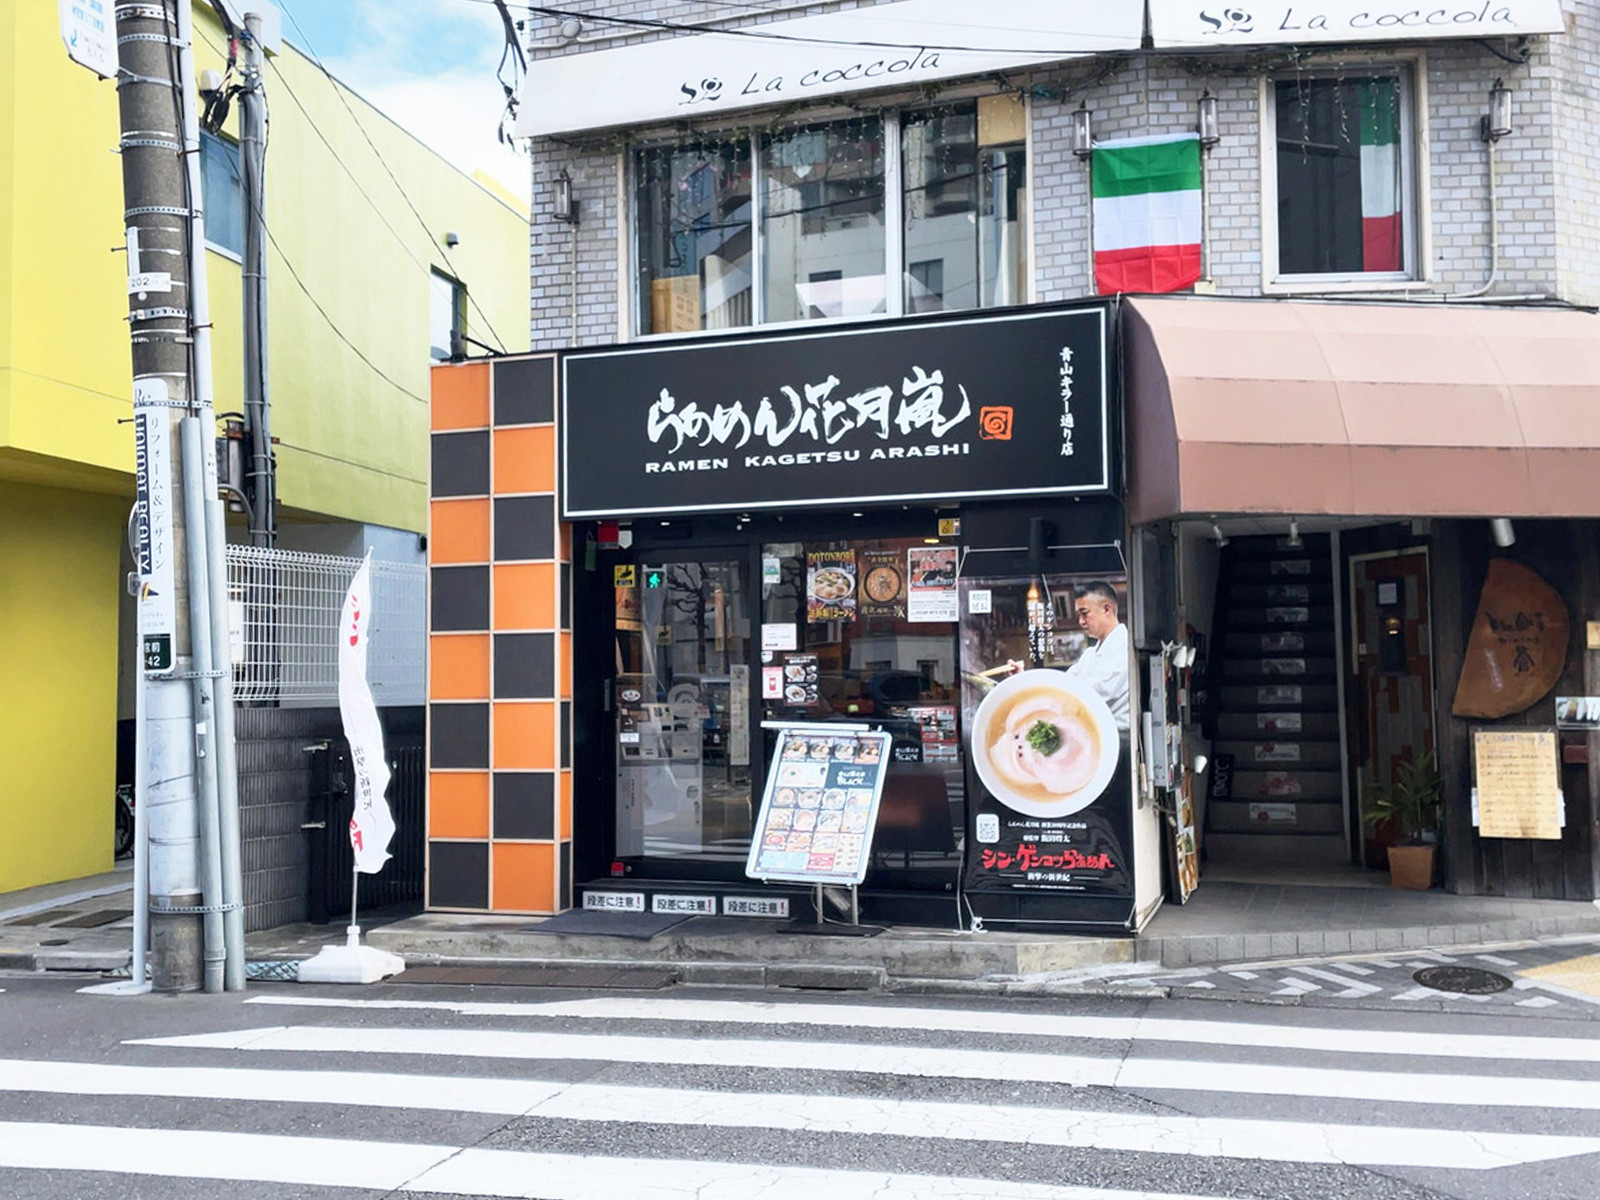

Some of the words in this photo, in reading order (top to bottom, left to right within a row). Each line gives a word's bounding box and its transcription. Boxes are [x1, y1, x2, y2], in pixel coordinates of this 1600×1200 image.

[1279, 8, 1329, 31] La
[1350, 0, 1517, 28] coccola
[741, 72, 782, 95] La
[799, 46, 940, 87] coccola
[1060, 346, 1074, 456] 青山キラー通り店
[645, 457, 729, 473] RAMEN
[745, 450, 860, 468] KAGETSU
[870, 442, 970, 461] ARASHI
